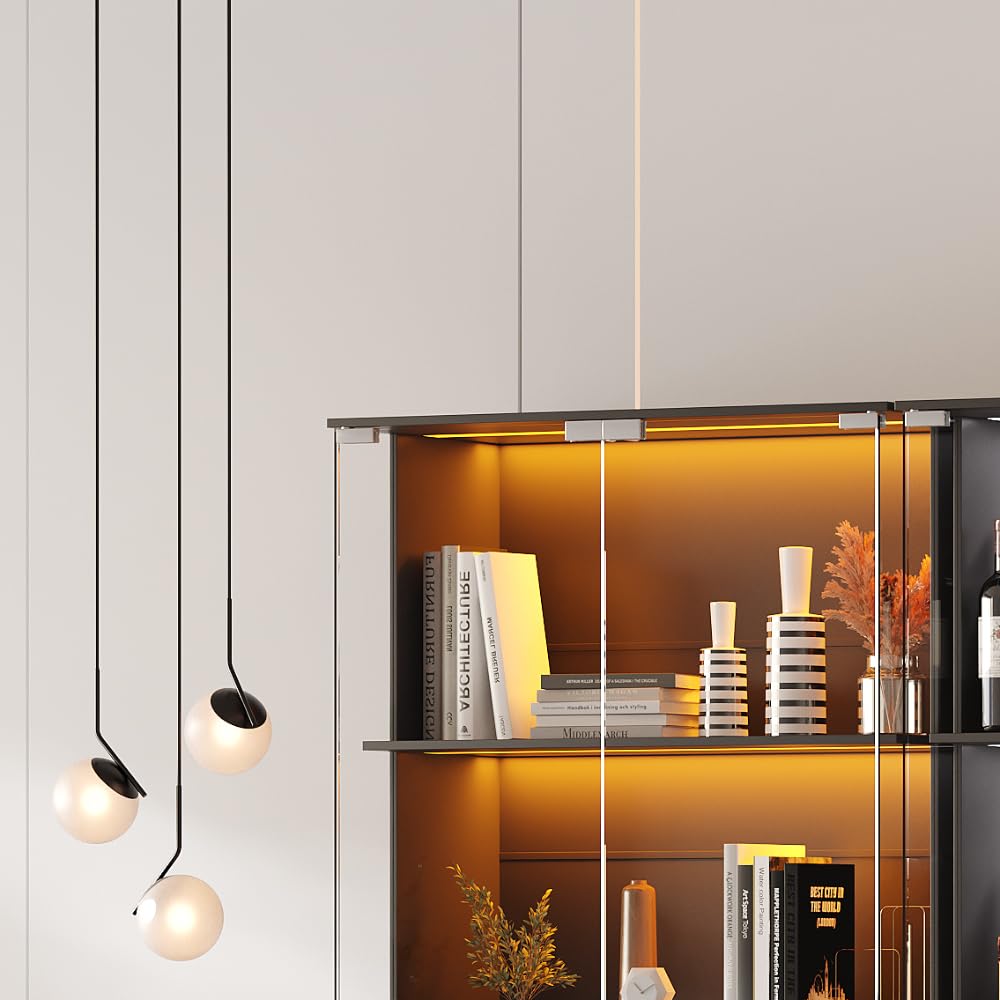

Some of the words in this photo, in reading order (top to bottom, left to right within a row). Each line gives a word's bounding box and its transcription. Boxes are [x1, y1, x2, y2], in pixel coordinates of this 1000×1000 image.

[630, 702, 647, 710] styling
[809, 886, 823, 898] BEST
[824, 886, 837, 898] CITY
[810, 901, 821, 912] THE
[821, 901, 841, 912] WORLD
